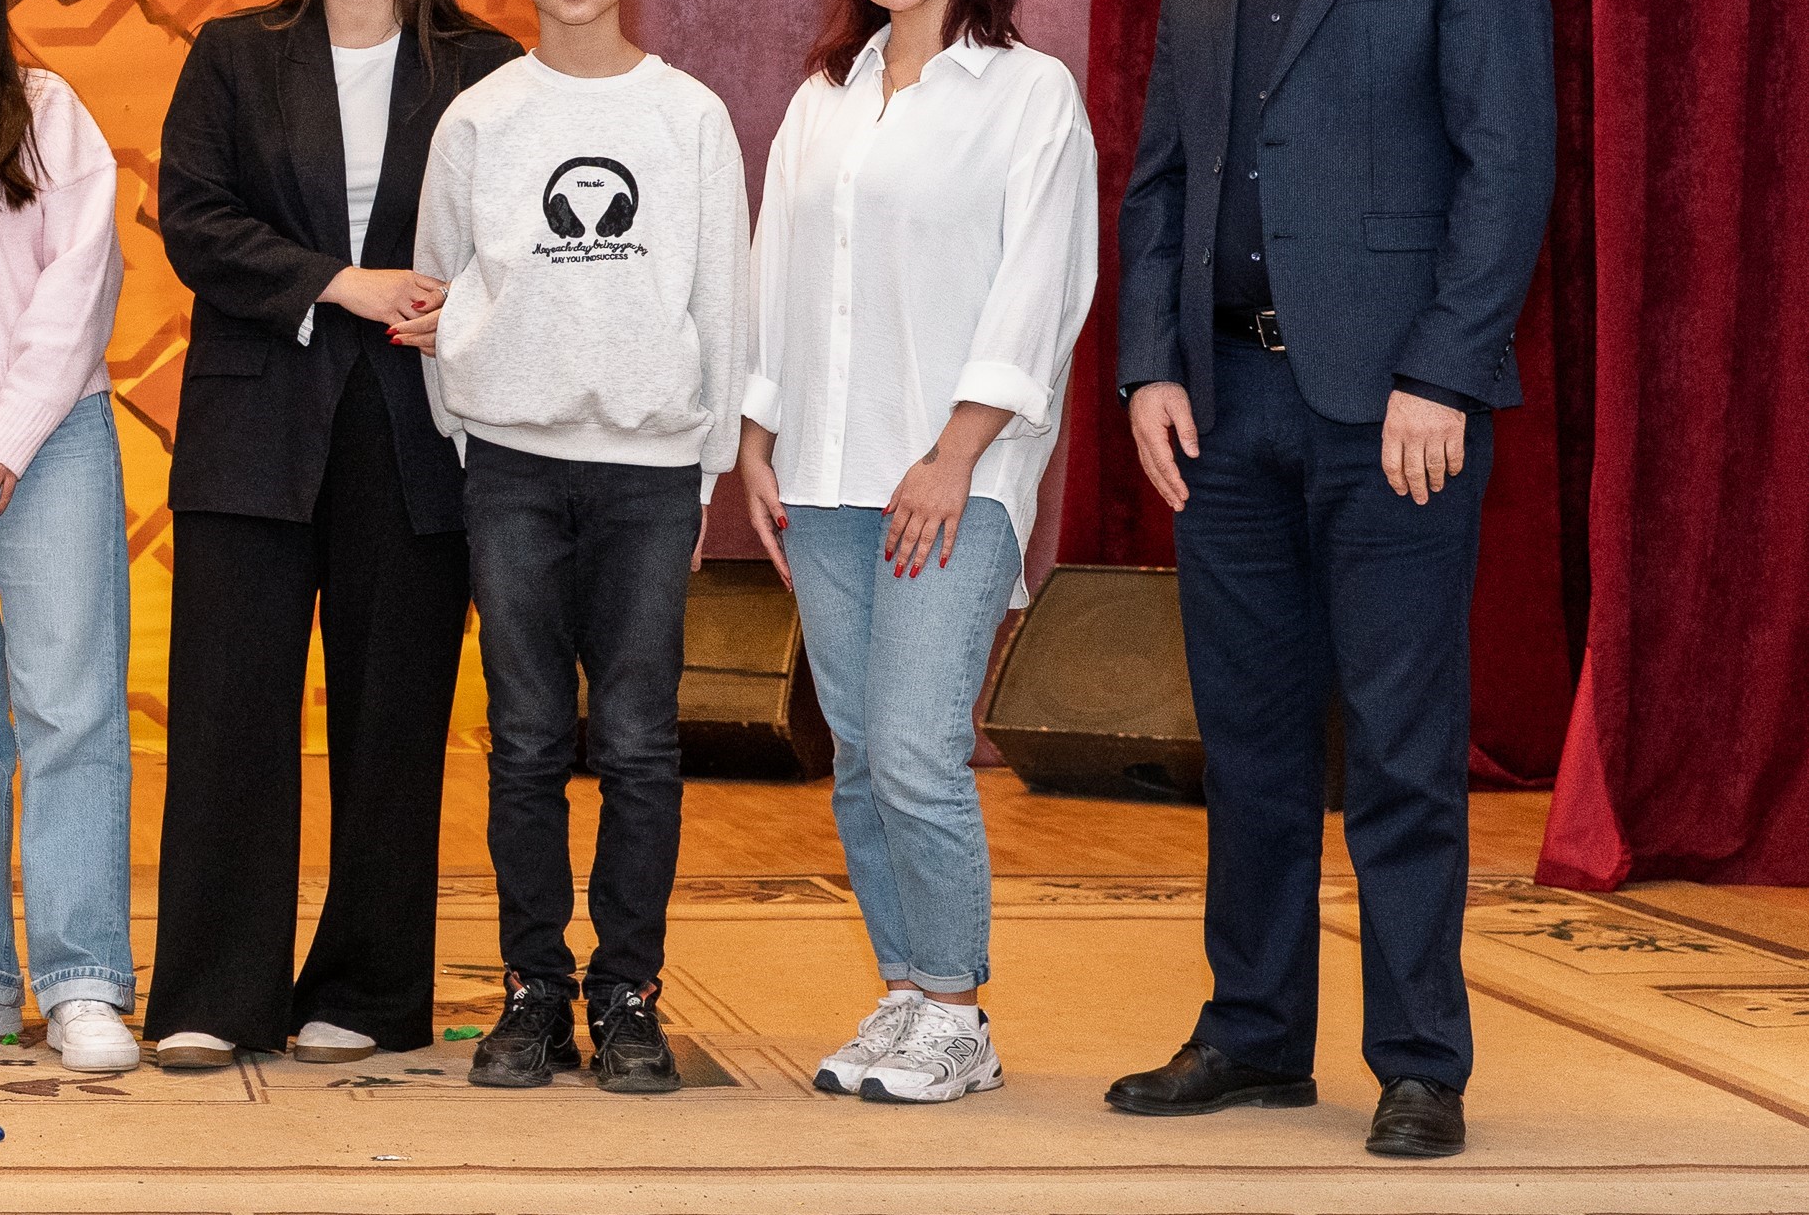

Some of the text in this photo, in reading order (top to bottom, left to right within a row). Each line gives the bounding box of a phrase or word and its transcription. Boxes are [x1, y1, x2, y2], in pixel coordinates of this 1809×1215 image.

[576, 179, 605, 187] music
[551, 256, 566, 264] MAY
[566, 255, 581, 263] YOU
[596, 253, 629, 261] SUCCESS
